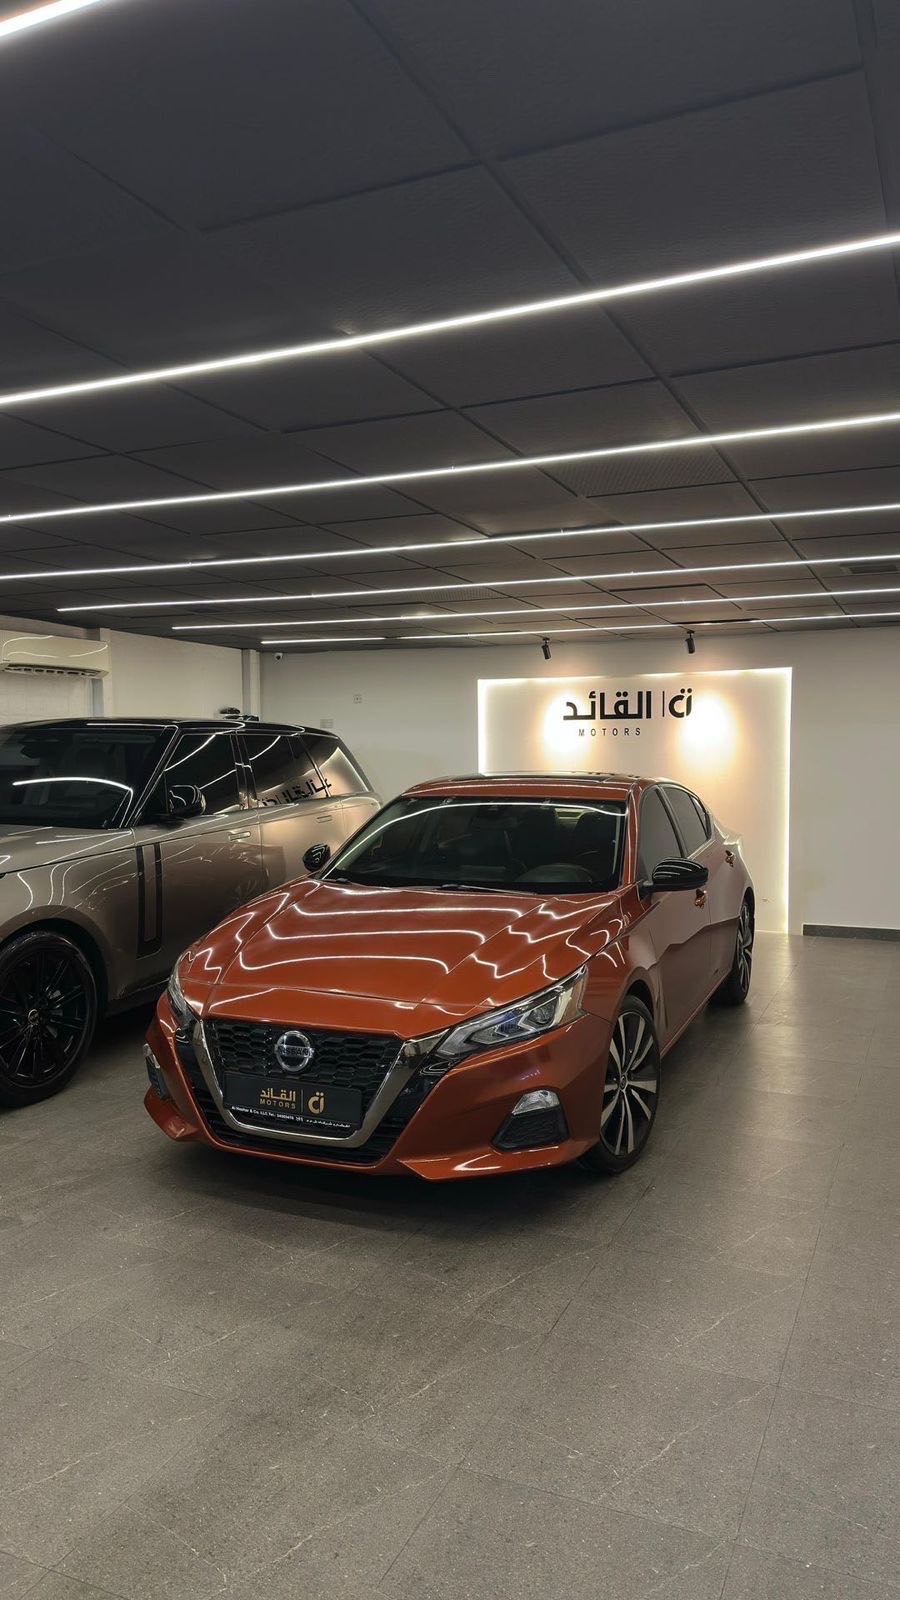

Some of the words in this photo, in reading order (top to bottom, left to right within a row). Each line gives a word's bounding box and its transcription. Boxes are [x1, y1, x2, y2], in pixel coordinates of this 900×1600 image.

[563, 690, 652, 721] القائد
[578, 727, 641, 737] MOTORS
[260, 1088, 296, 1101] القائد
[259, 1098, 296, 1109] MOTORS
